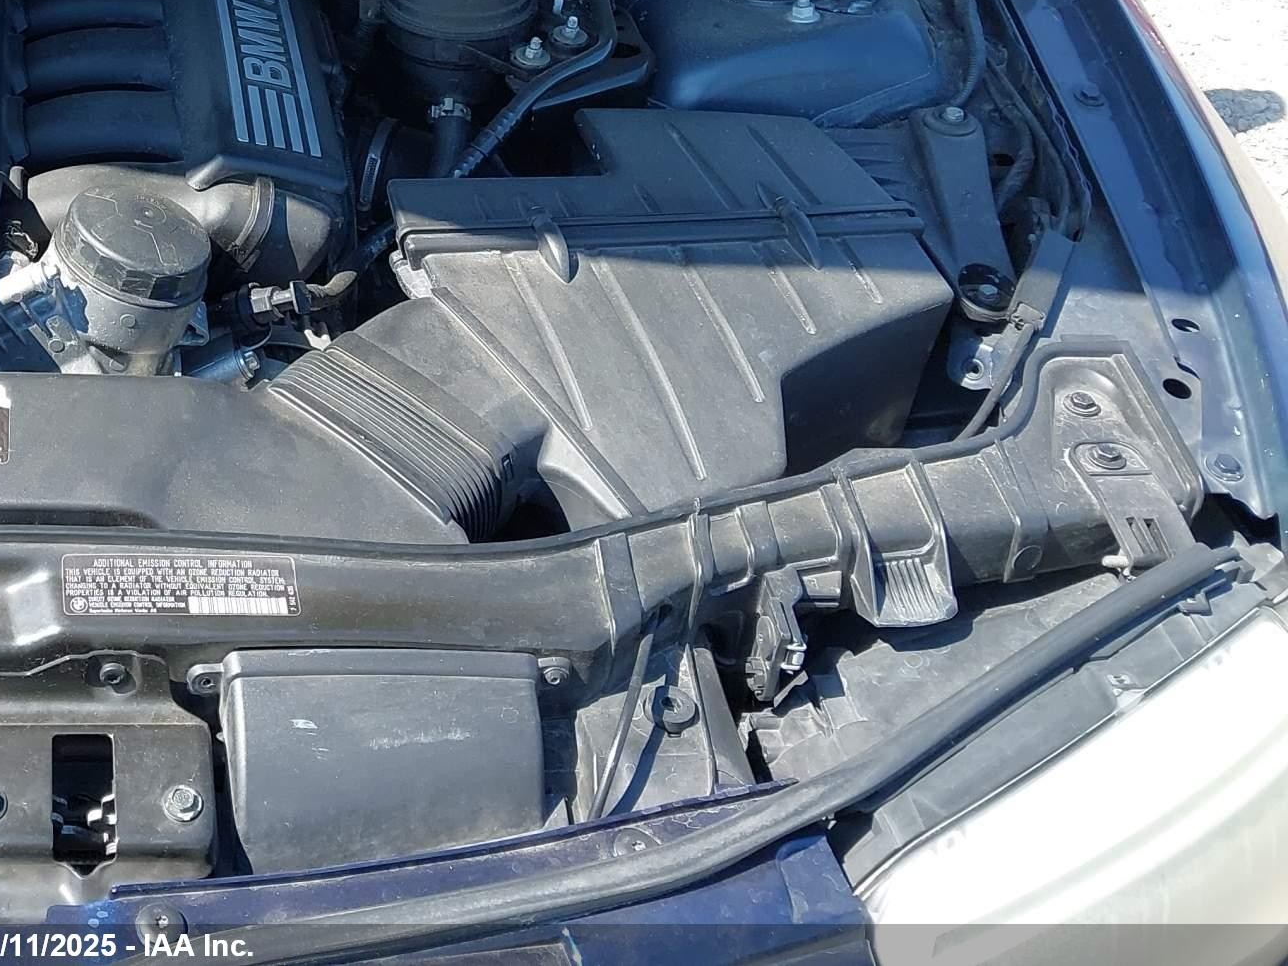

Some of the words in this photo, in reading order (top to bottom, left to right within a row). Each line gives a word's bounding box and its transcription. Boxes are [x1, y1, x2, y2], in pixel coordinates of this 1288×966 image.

[232, 0, 292, 88] BMW
[93, 559, 134, 567] ADDITIONAL
[138, 559, 170, 567] EMISSION
[174, 559, 203, 568] CONTROL
[207, 560, 252, 568] INFORMATION
[248, 569, 279, 577] RADIATOR
